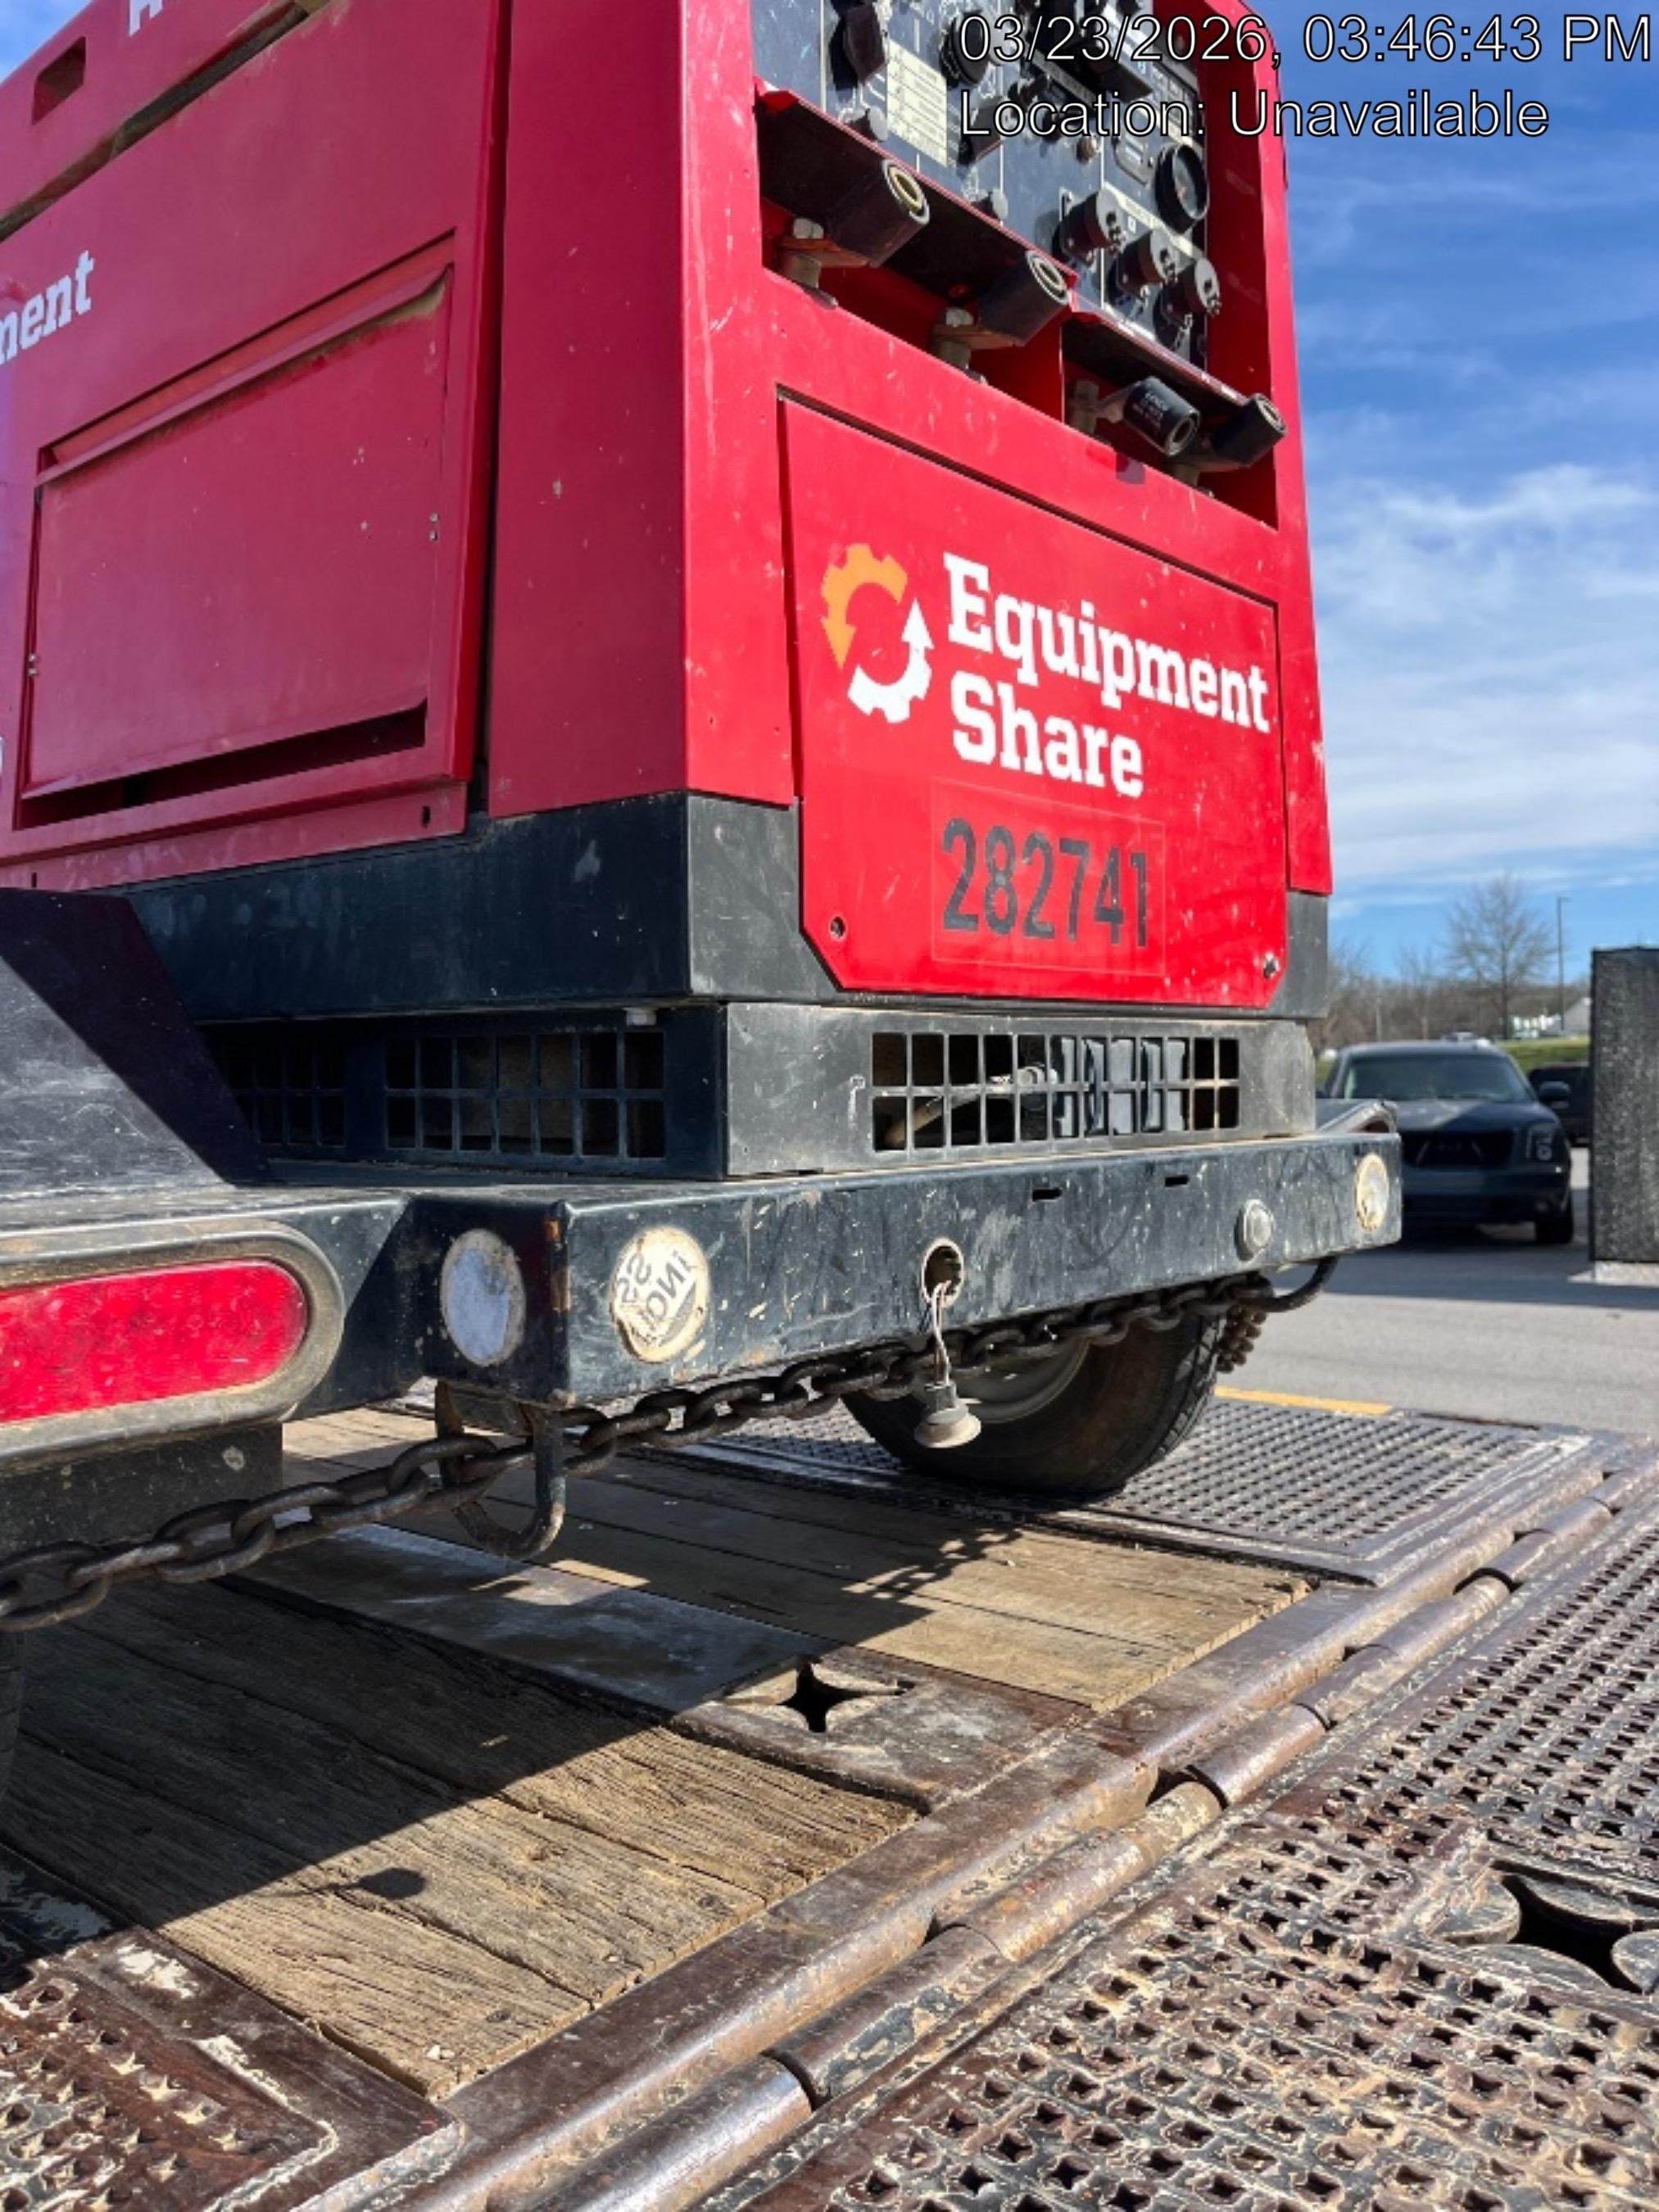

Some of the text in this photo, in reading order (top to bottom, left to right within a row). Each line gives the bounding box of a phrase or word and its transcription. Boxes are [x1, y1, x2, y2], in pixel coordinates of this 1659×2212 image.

[943, 551, 1271, 734] Equipment
[950, 669, 1145, 799] Share
[941, 816, 1149, 948] 282741
